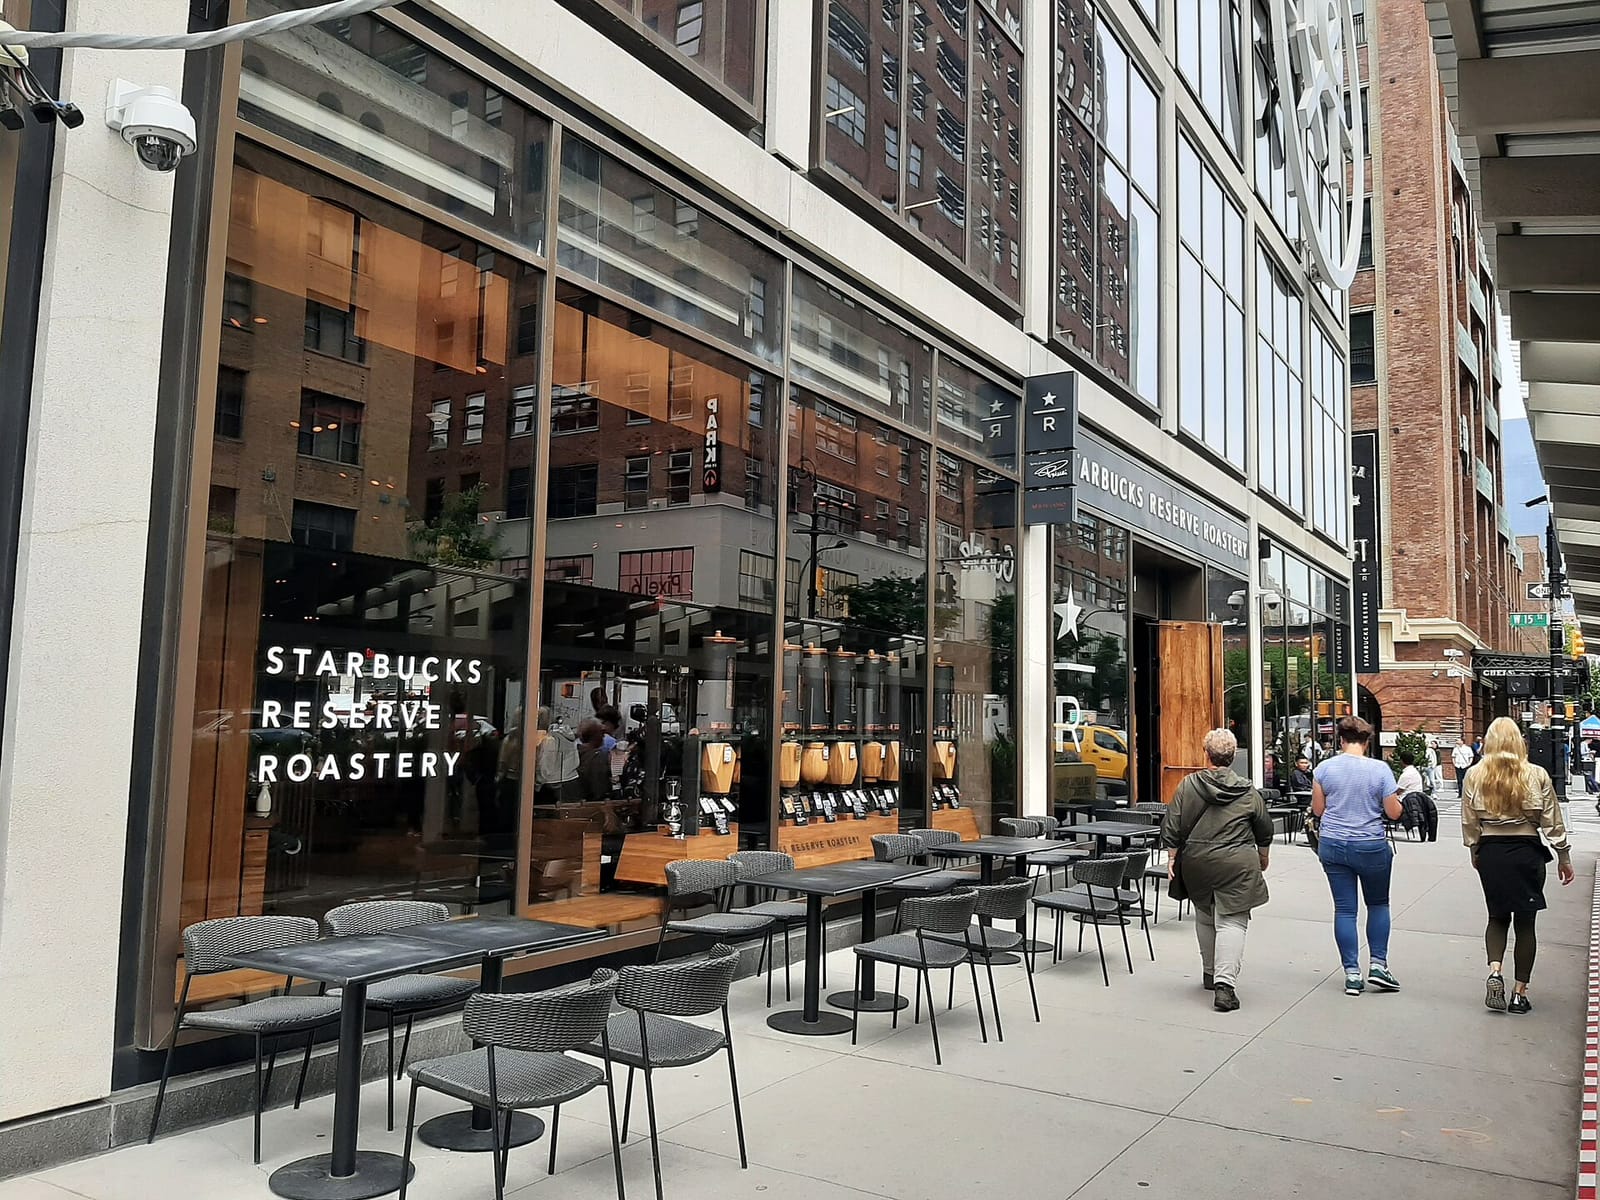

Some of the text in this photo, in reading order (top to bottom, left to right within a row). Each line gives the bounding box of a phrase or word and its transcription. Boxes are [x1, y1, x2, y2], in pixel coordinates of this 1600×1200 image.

[1043, 416, 1056, 432] R
[1078, 455, 1248, 559] ARBUCKS RESERVE ROASTERY
[1513, 614, 1521, 625] W
[1524, 614, 1534, 625] 15
[266, 646, 483, 684] STARBUCKS
[261, 700, 441, 729] RESERVE
[1055, 695, 1081, 753] R
[258, 751, 461, 783] ROASTERY
[791, 840, 825, 852] RESERVE
